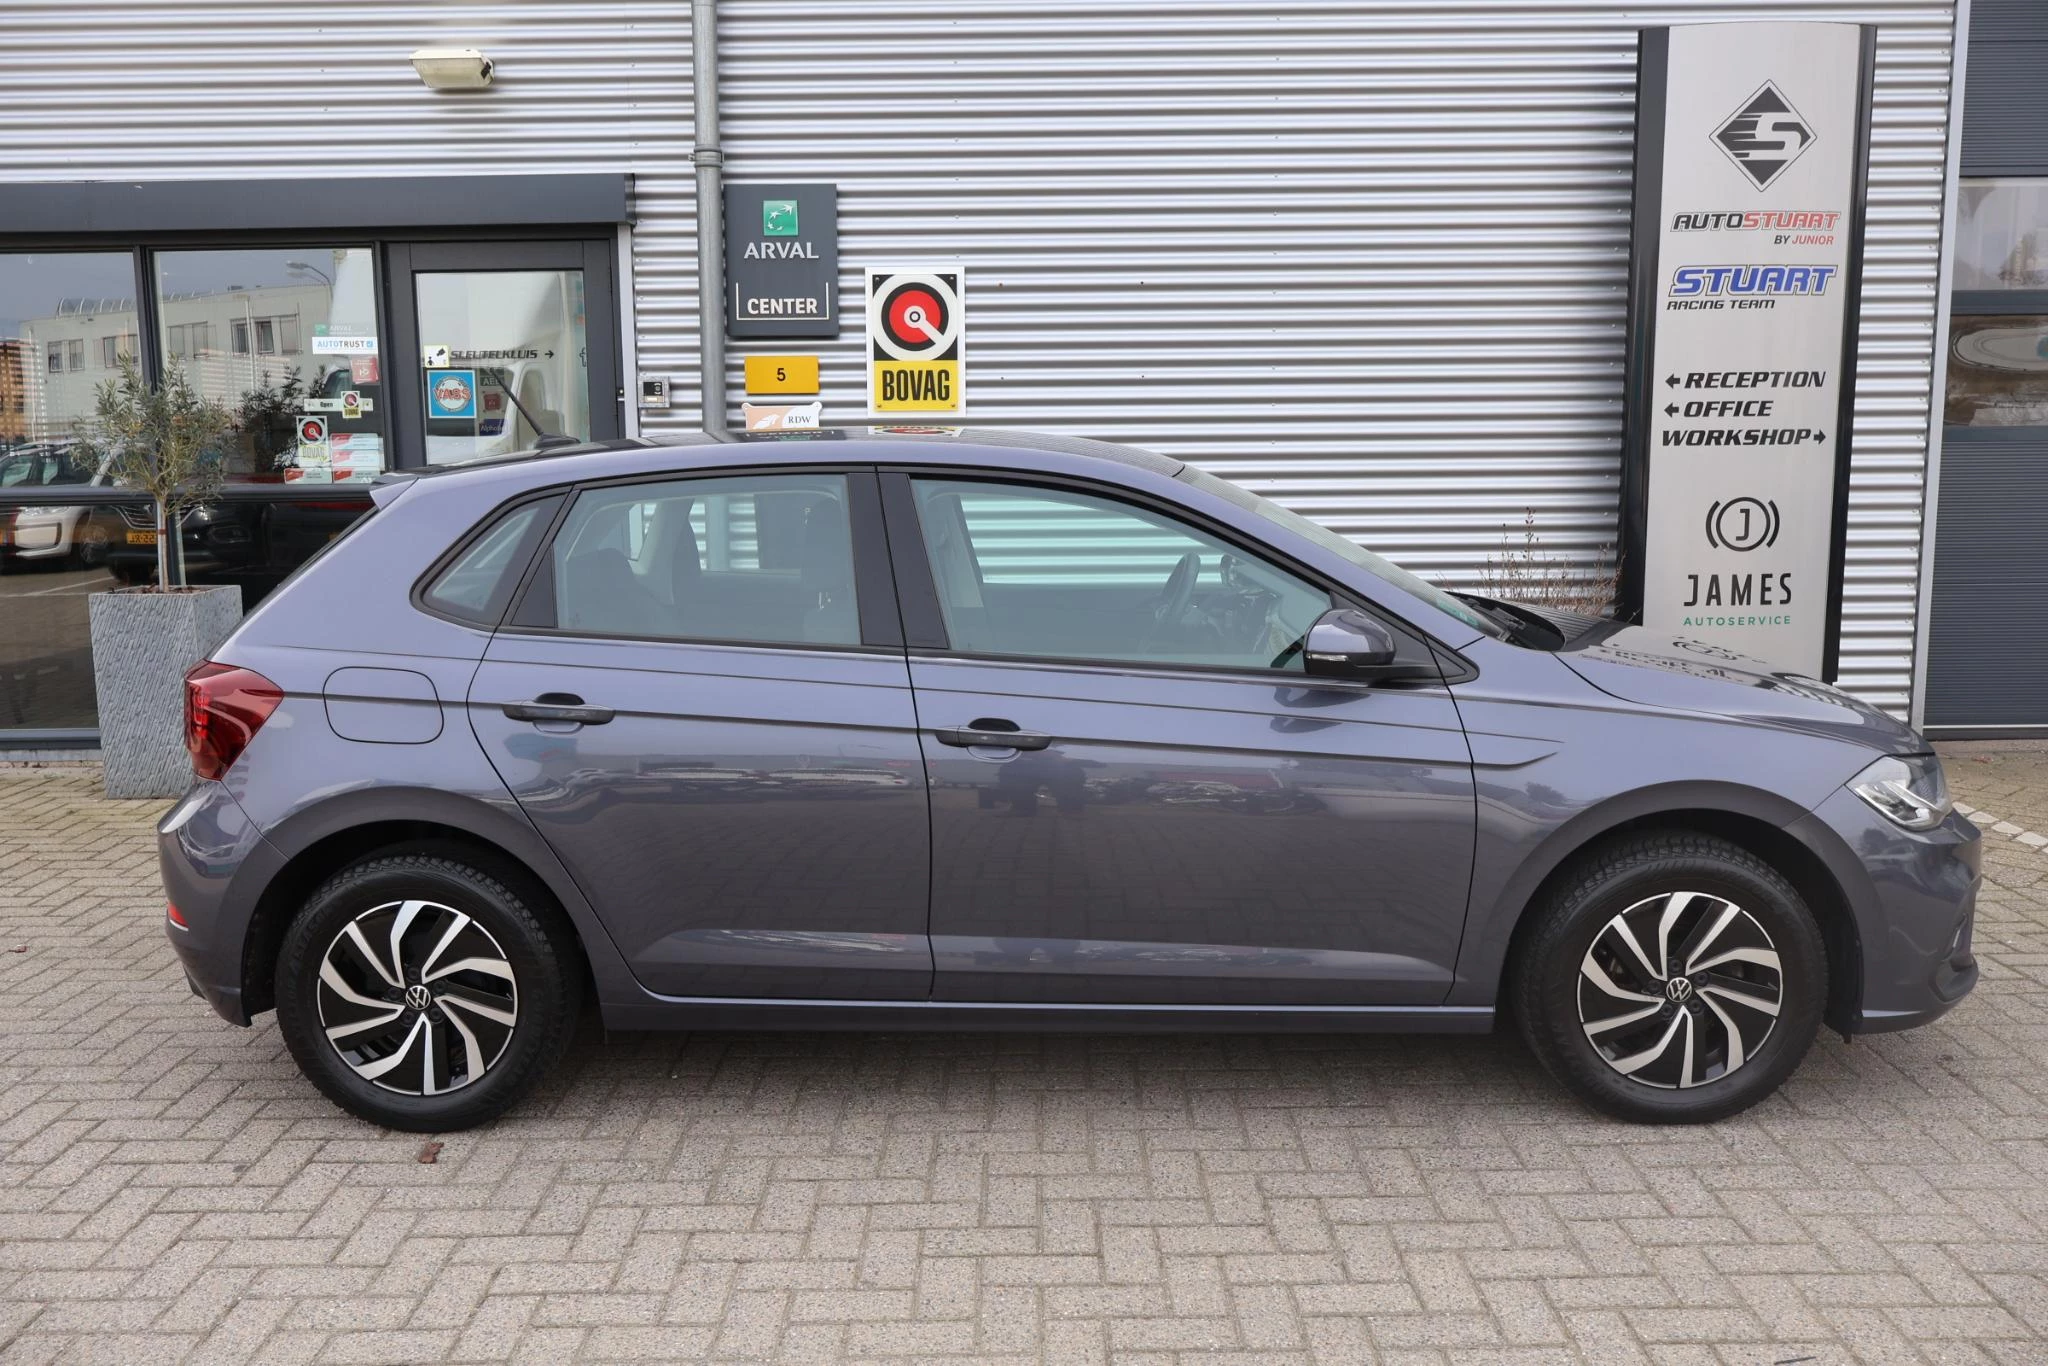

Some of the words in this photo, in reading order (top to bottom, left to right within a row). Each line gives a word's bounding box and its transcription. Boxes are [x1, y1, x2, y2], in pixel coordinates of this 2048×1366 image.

[1671, 211, 1841, 232] AUTOSTUART
[1774, 235, 1790, 245] BY
[1791, 235, 1834, 245] JUNIOR
[744, 242, 819, 259] ARVAL
[1669, 265, 1838, 297] STUART
[747, 298, 818, 315] CENTER
[1667, 300, 1724, 311] RACING
[1730, 300, 1775, 309] TEAM
[317, 340, 365, 348] AUTOTRUST
[776, 368, 786, 382] 5
[1684, 371, 1827, 389] RECEPTION
[882, 369, 950, 402] BOVAG
[1683, 400, 1774, 418] OFFICE
[788, 416, 812, 424] RDW
[1662, 429, 1812, 446] WORKSHOP
[1684, 573, 1792, 606] JAMES
[1683, 616, 1791, 626] AUTOSERVICE
